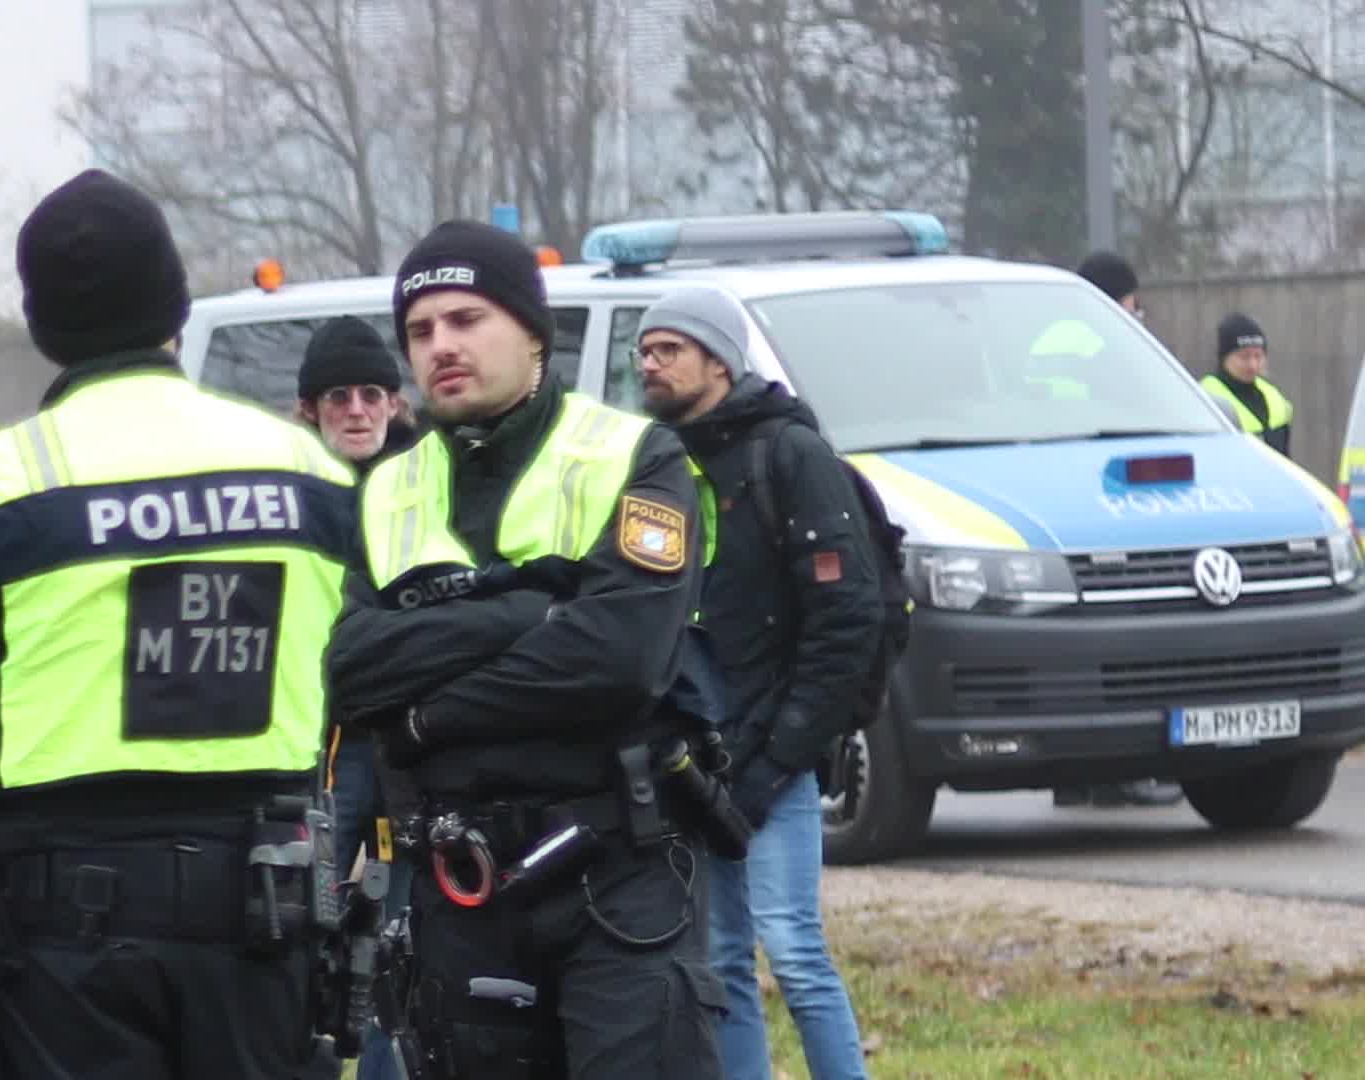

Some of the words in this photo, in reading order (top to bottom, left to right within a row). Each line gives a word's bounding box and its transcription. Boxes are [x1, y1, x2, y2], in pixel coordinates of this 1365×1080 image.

[402, 267, 475, 297] POLIZEI
[87, 484, 300, 544] POLIZEI
[629, 503, 681, 529] POLIZEI
[180, 573, 240, 621] BY
[398, 570, 475, 609] OLIZEI
[136, 628, 173, 674] M
[189, 626, 269, 674] 7131
